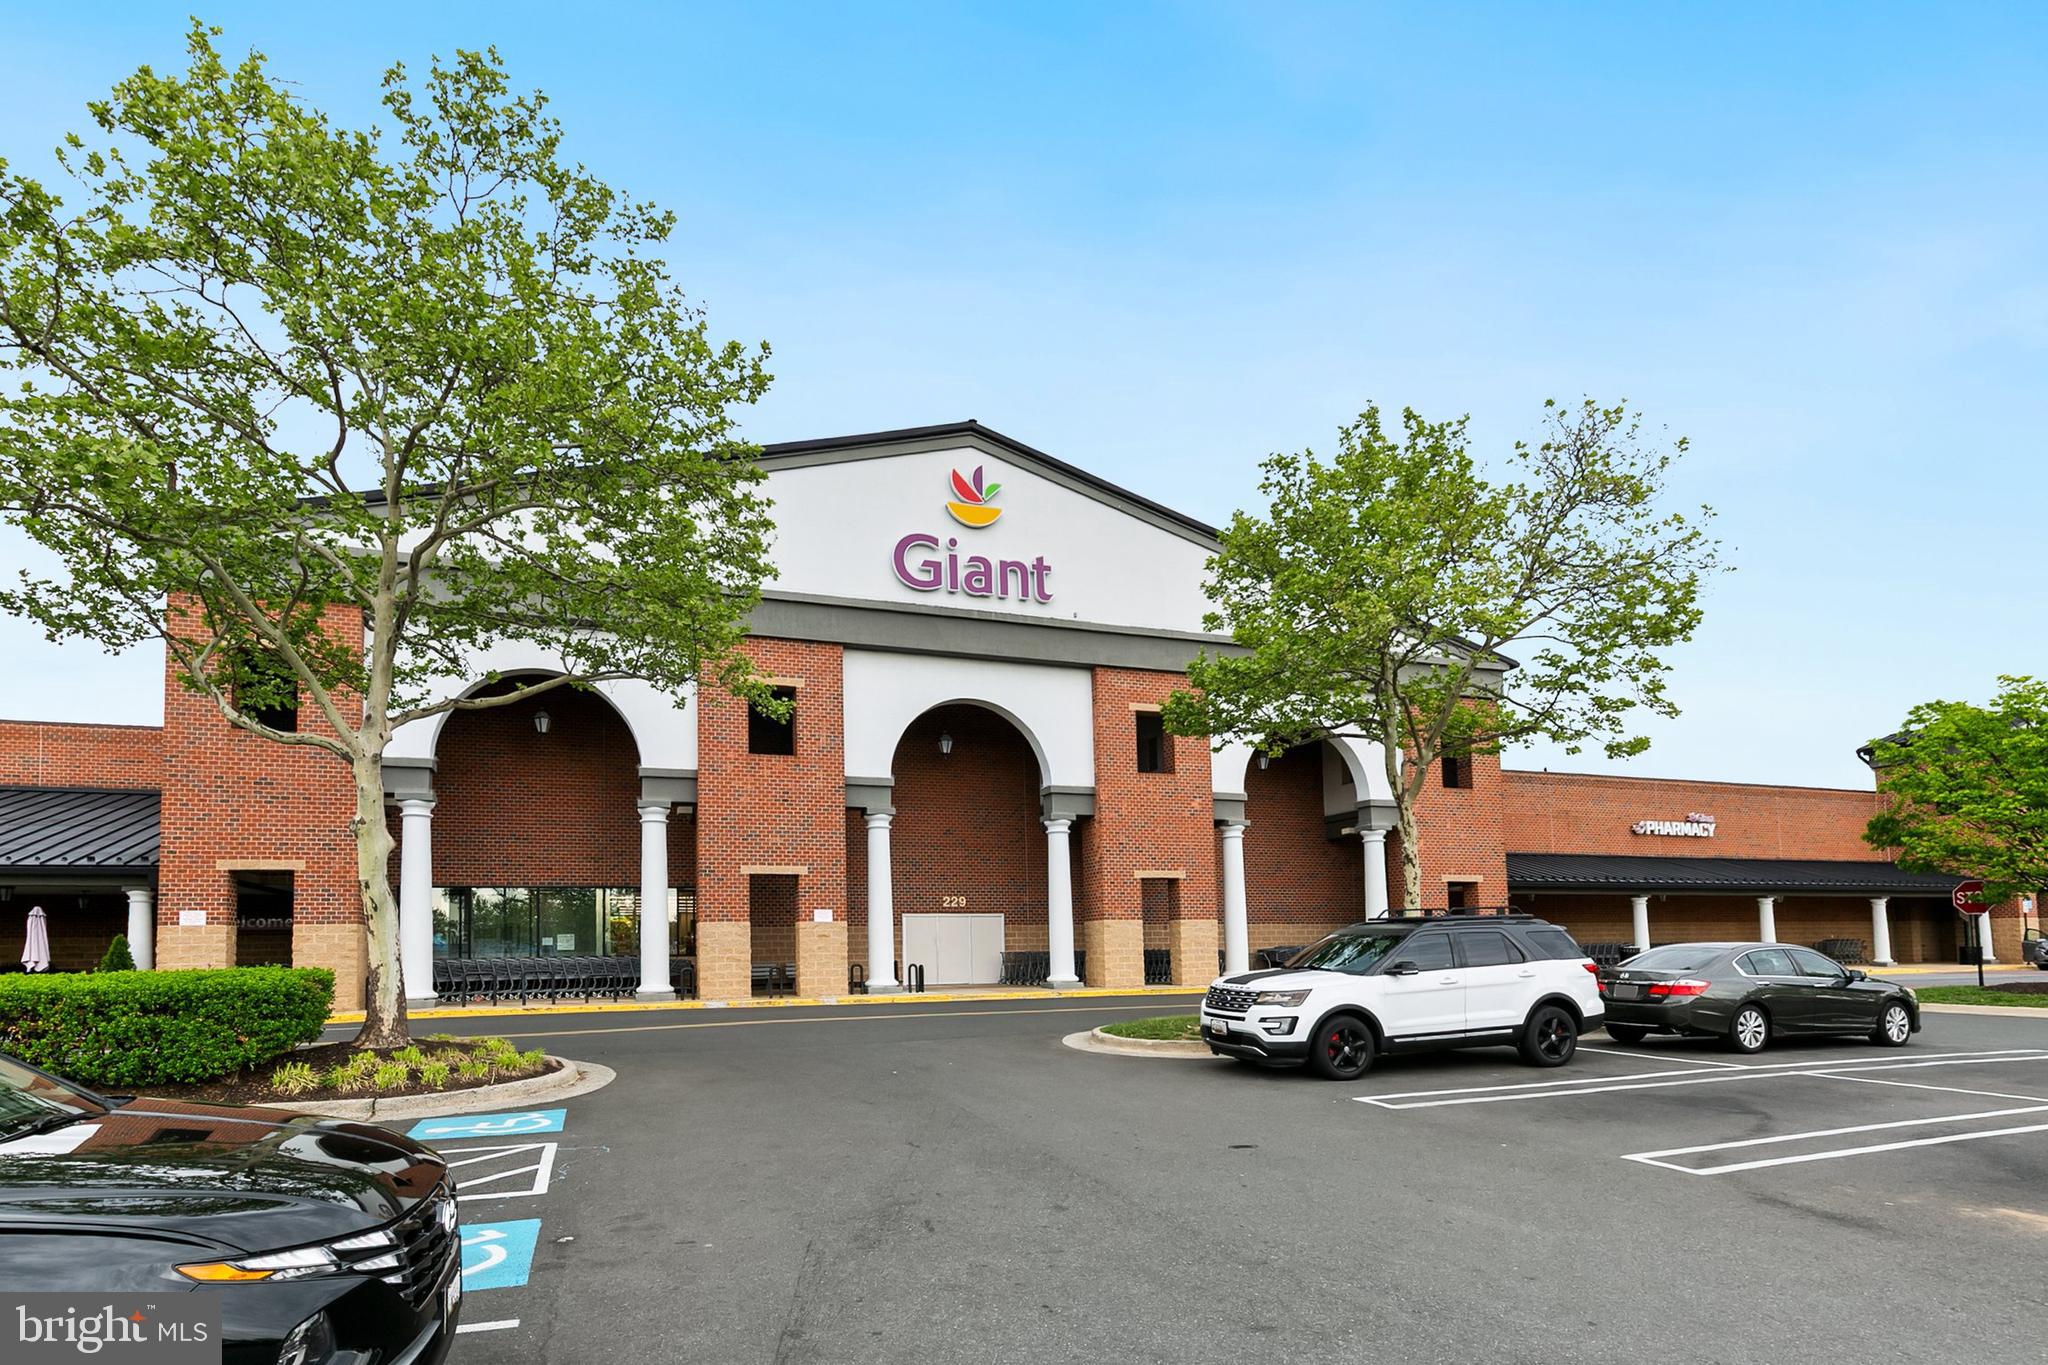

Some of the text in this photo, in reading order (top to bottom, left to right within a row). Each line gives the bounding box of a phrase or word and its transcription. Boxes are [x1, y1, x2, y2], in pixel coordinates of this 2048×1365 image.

[892, 533, 1054, 603] Giant
[1645, 820, 1716, 837] PHARMACY
[942, 896, 967, 908] 229
[1956, 890, 1984, 905] ST
[235, 914, 293, 928] elcome
